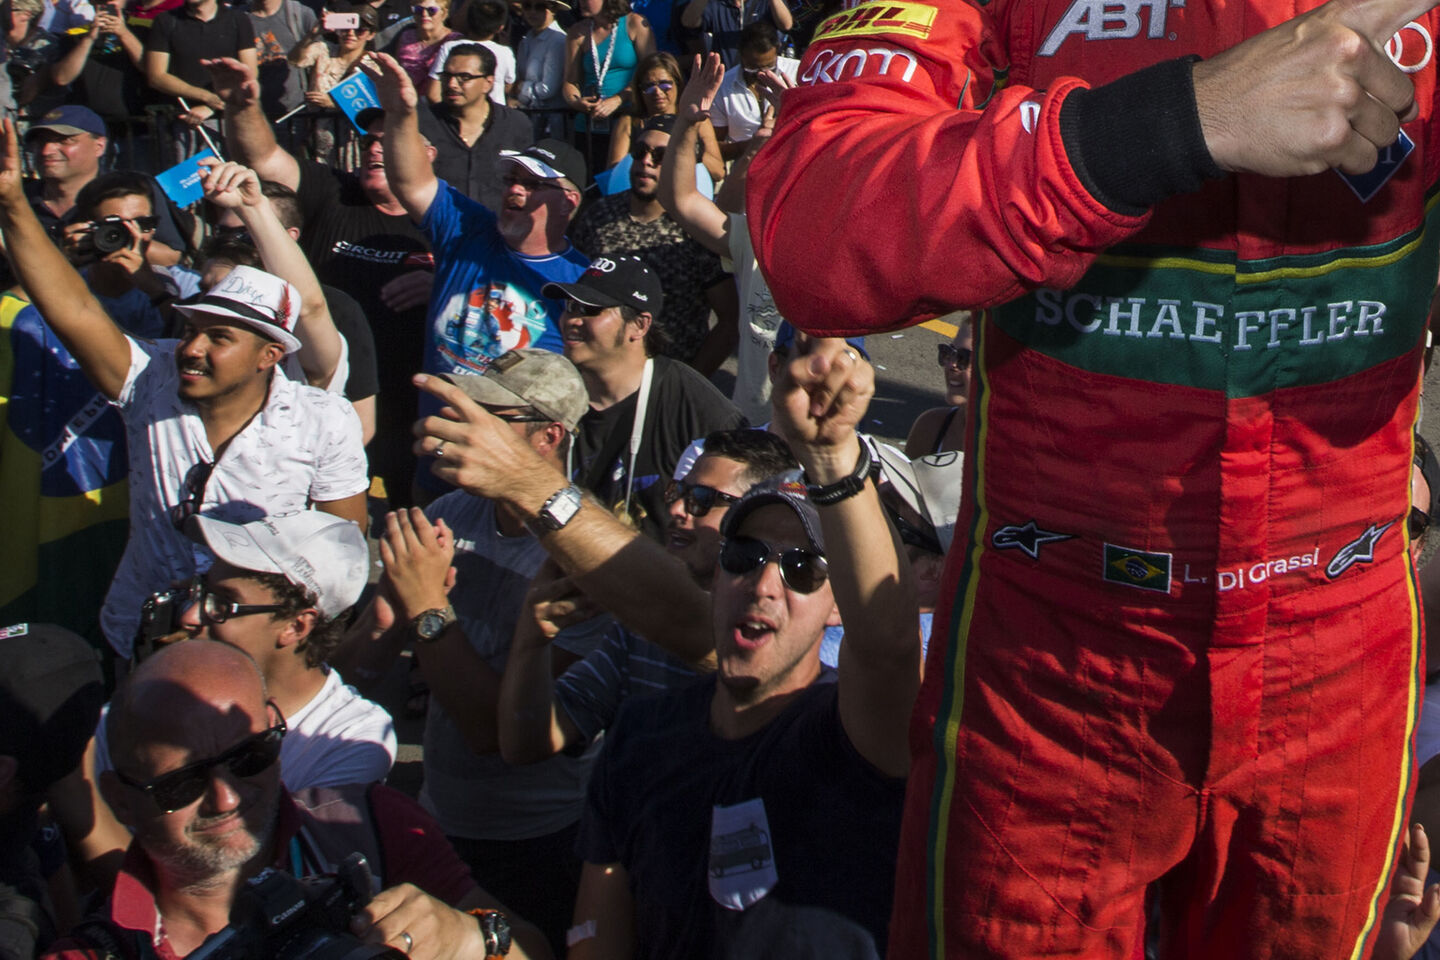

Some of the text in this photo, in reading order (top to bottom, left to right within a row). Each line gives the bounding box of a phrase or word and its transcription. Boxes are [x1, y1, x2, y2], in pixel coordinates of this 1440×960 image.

[819, 6, 906, 35] DHL
[332, 240, 408, 259] CIRCUIT
[1035, 289, 1388, 352] SCHAEFFLER
[1183, 564, 1208, 584] L.
[1249, 546, 1321, 584] Grassi
[272, 899, 305, 925] Canon
